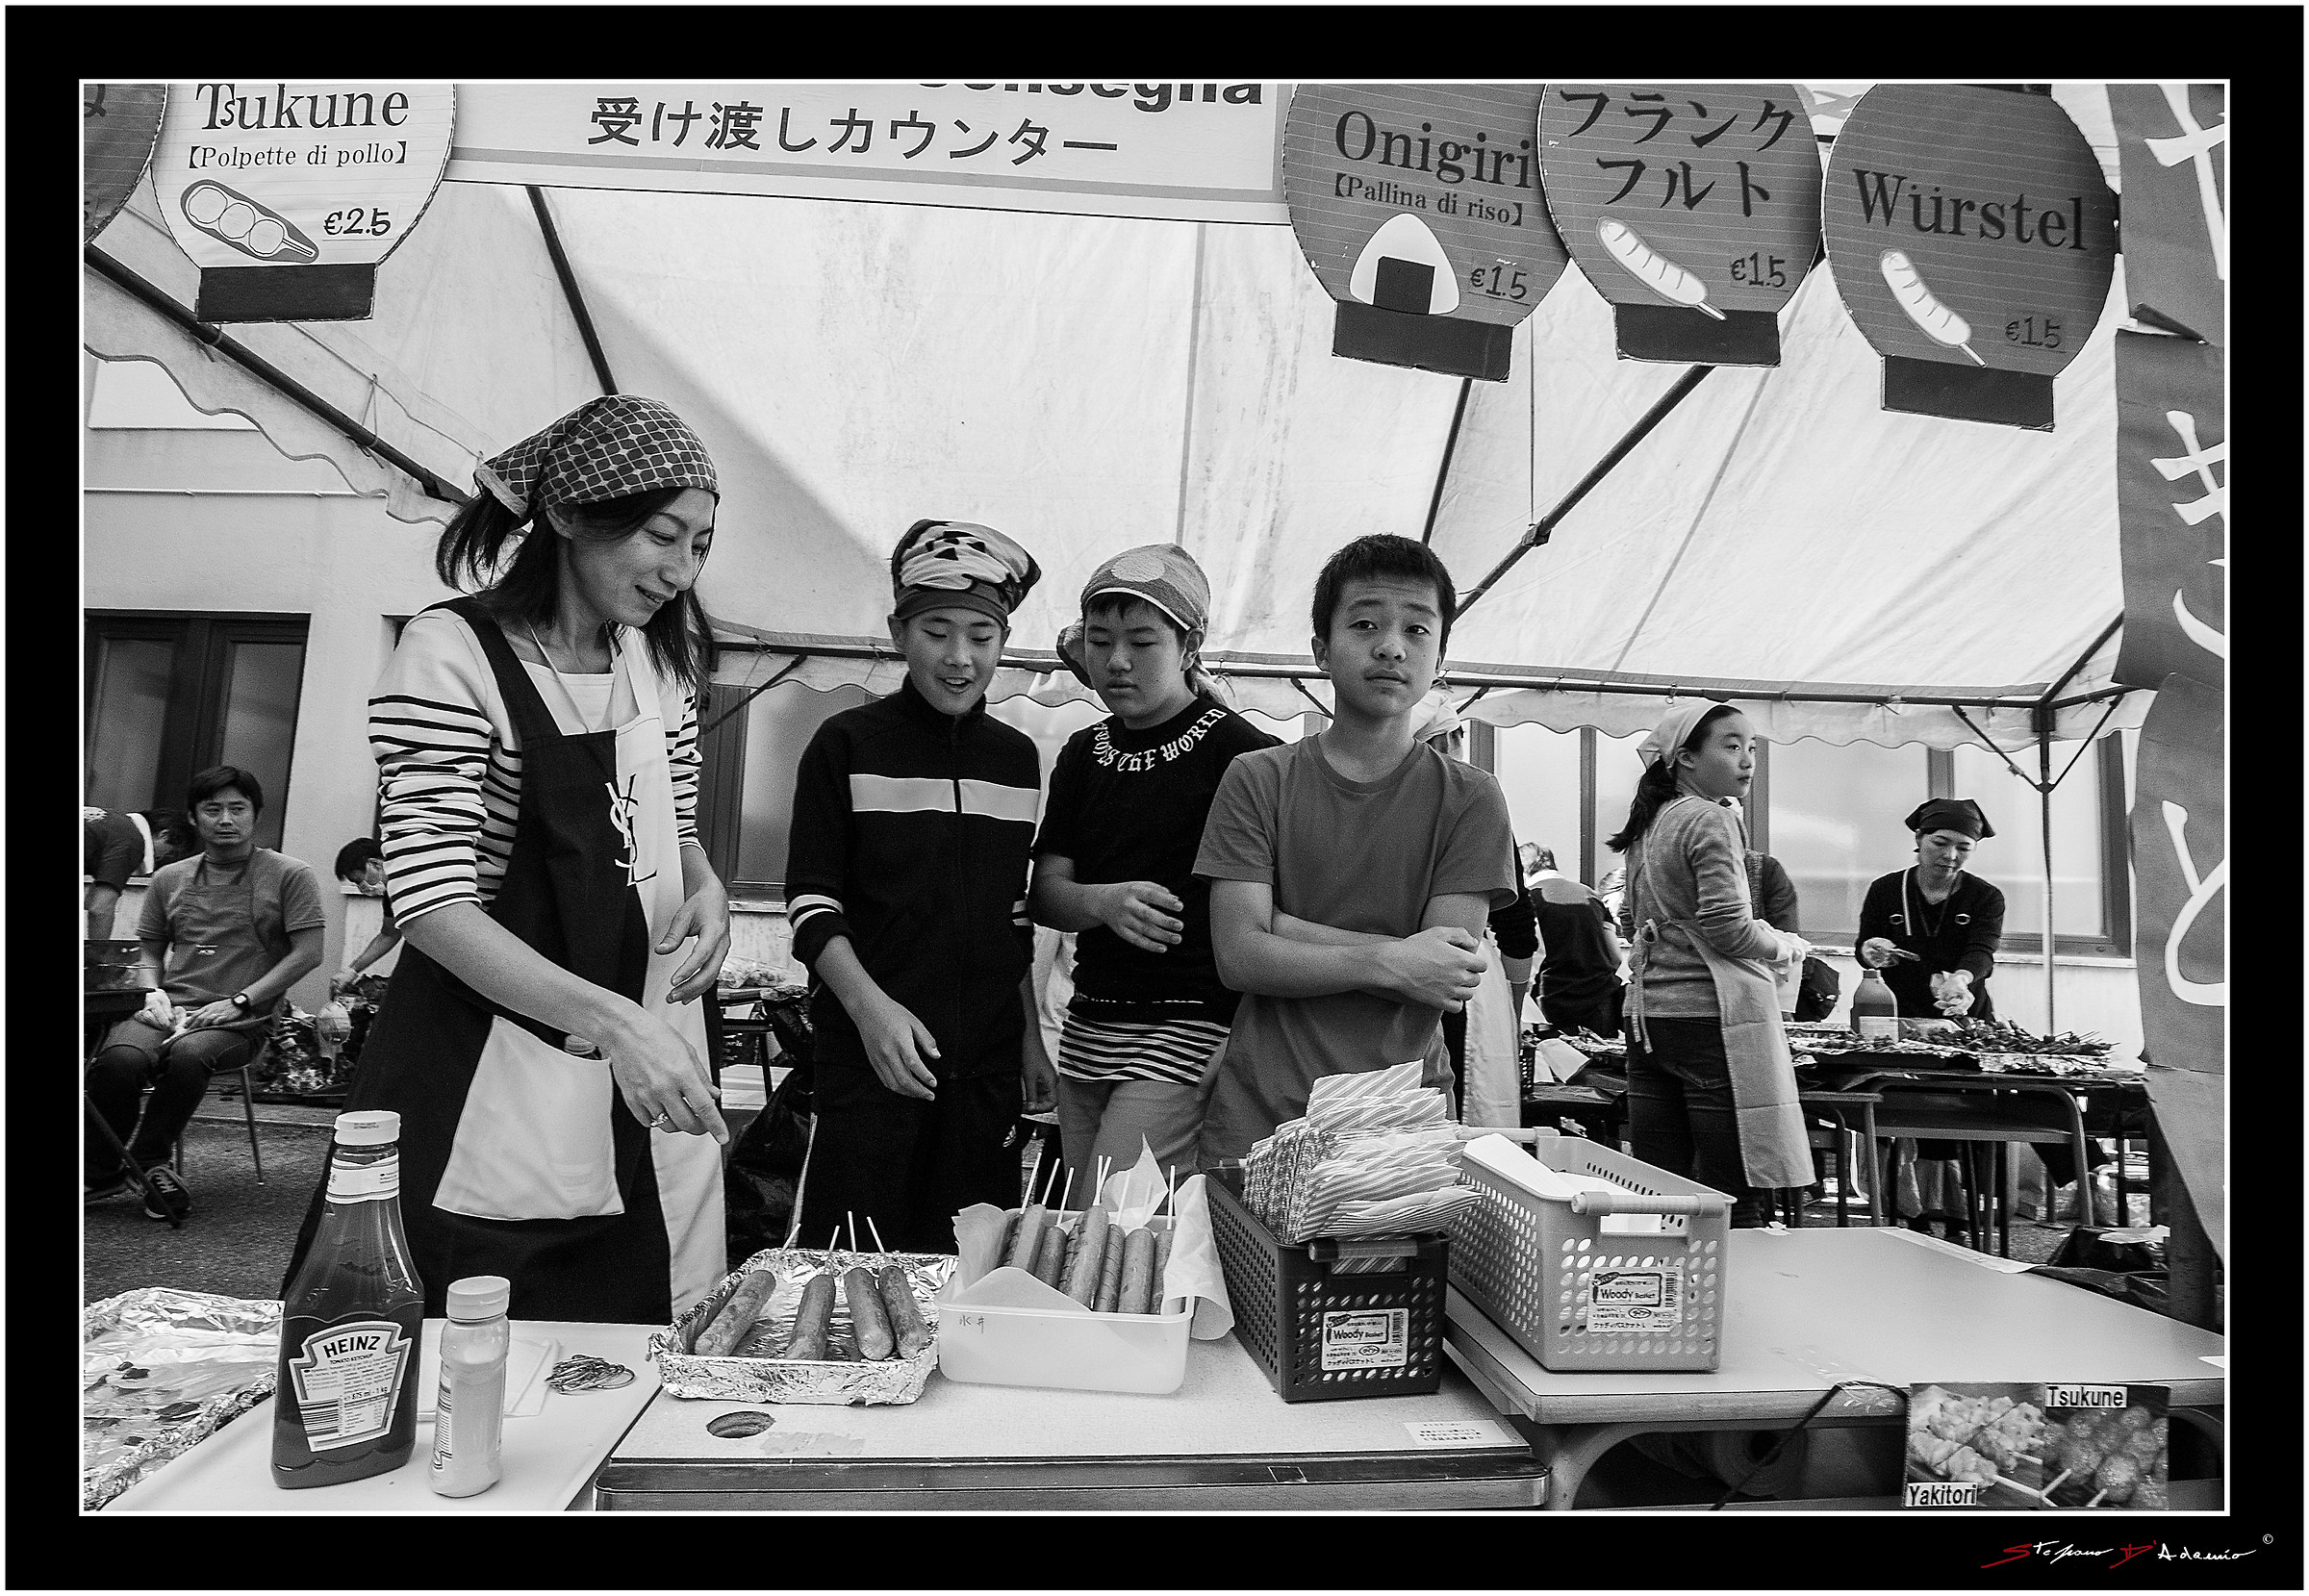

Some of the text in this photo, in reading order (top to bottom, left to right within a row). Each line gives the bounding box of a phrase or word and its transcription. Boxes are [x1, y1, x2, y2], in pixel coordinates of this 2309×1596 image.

[195, 84, 409, 130] Tsukune
[1560, 89, 1796, 152] フランク
[587, 96, 1119, 166] 受け渡しカウンター
[306, 144, 327, 165] di
[1335, 111, 1532, 189] Onigiri
[1437, 189, 1458, 215] di
[1596, 157, 1770, 217] フルト
[323, 208, 392, 237] €2.5
[1852, 168, 2088, 251] Würstel
[1470, 266, 1528, 300] €1.5
[1731, 251, 1787, 289] €1.5
[1159, 708, 1228, 761] WORLD
[1600, 1288, 1634, 1302] Woody
[323, 1335, 381, 1358] HEINZ
[1333, 1329, 1364, 1341] Woody
[2046, 1385, 2124, 1406] Tsukune
[1908, 1483, 1978, 1507] Yakitori
